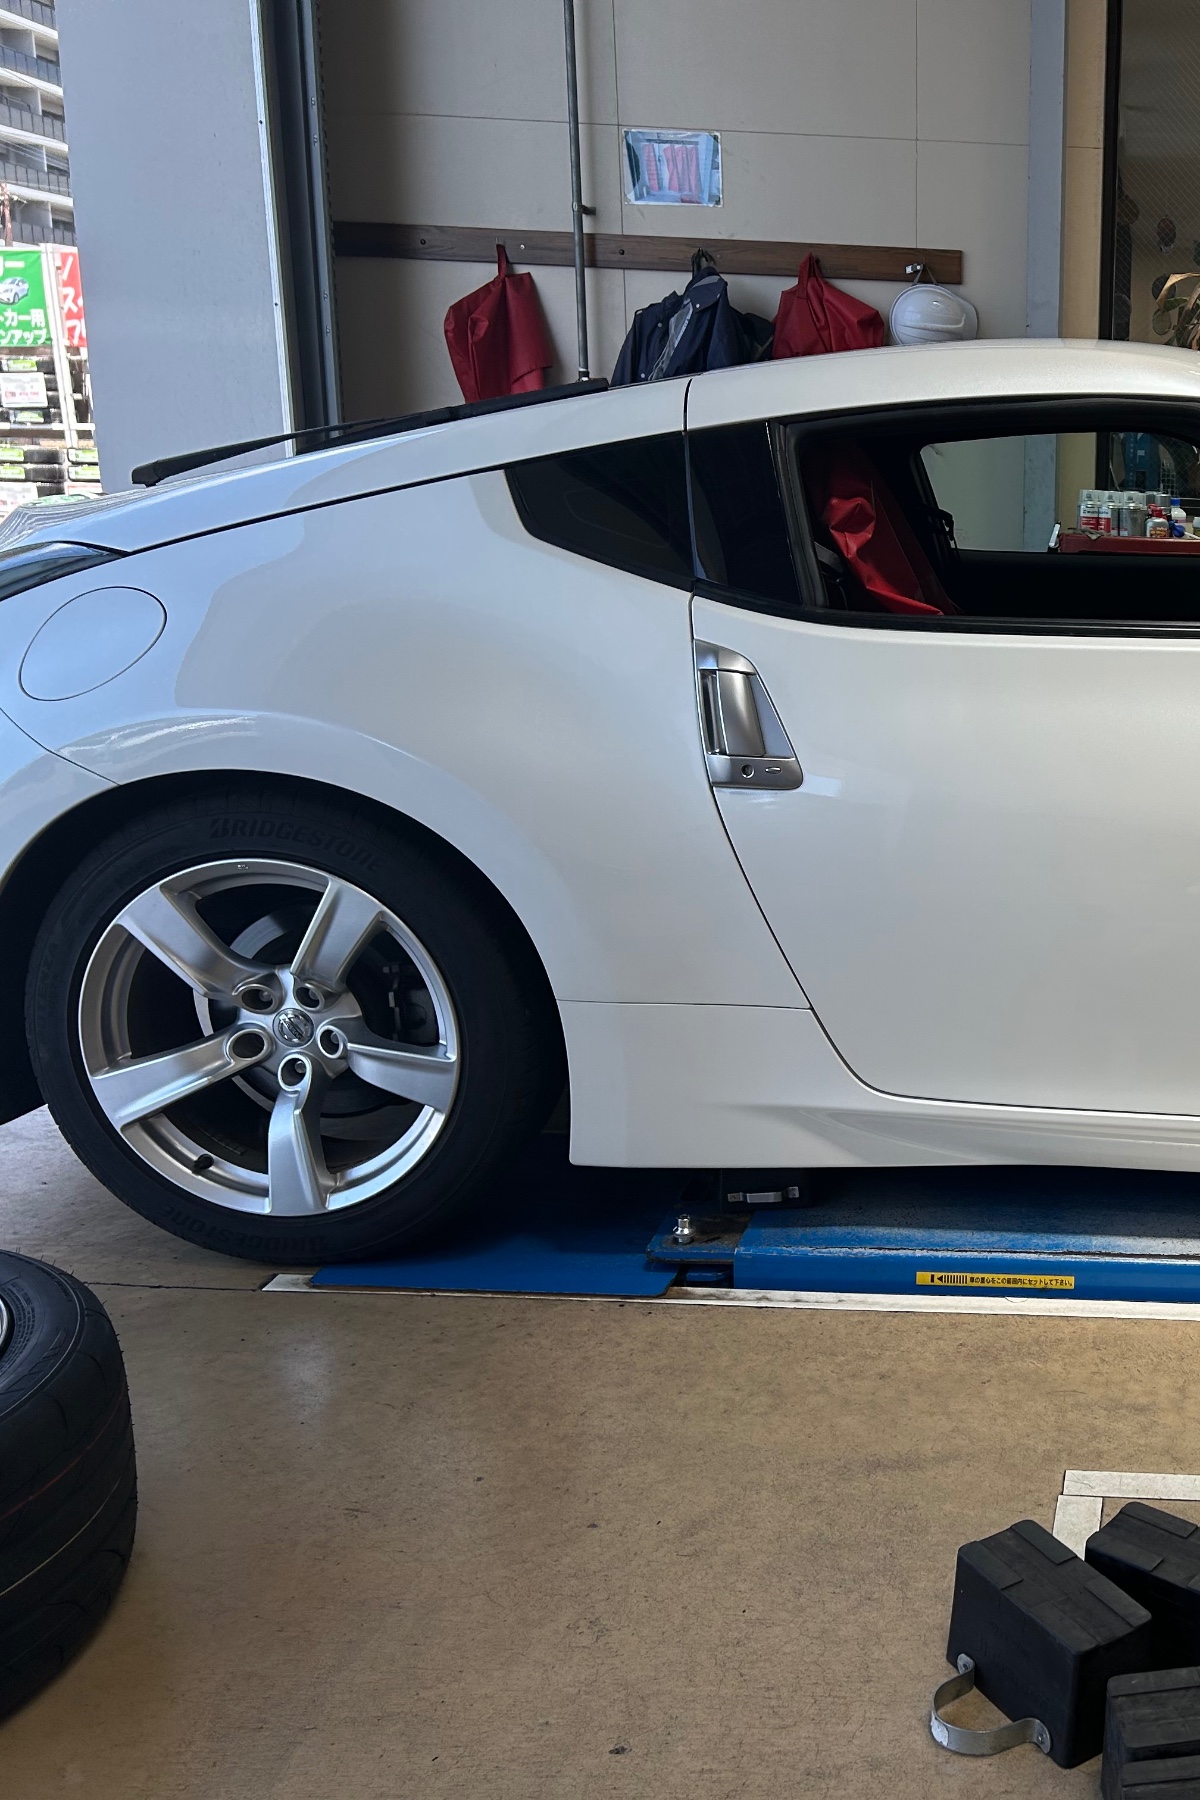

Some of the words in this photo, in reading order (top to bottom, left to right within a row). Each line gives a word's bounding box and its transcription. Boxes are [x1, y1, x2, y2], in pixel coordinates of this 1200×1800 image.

[209, 817, 386, 872] BRIDGESTONE
[970, 1276, 1073, 1287] 車の重心をこの範囲内にセットして下さい。
